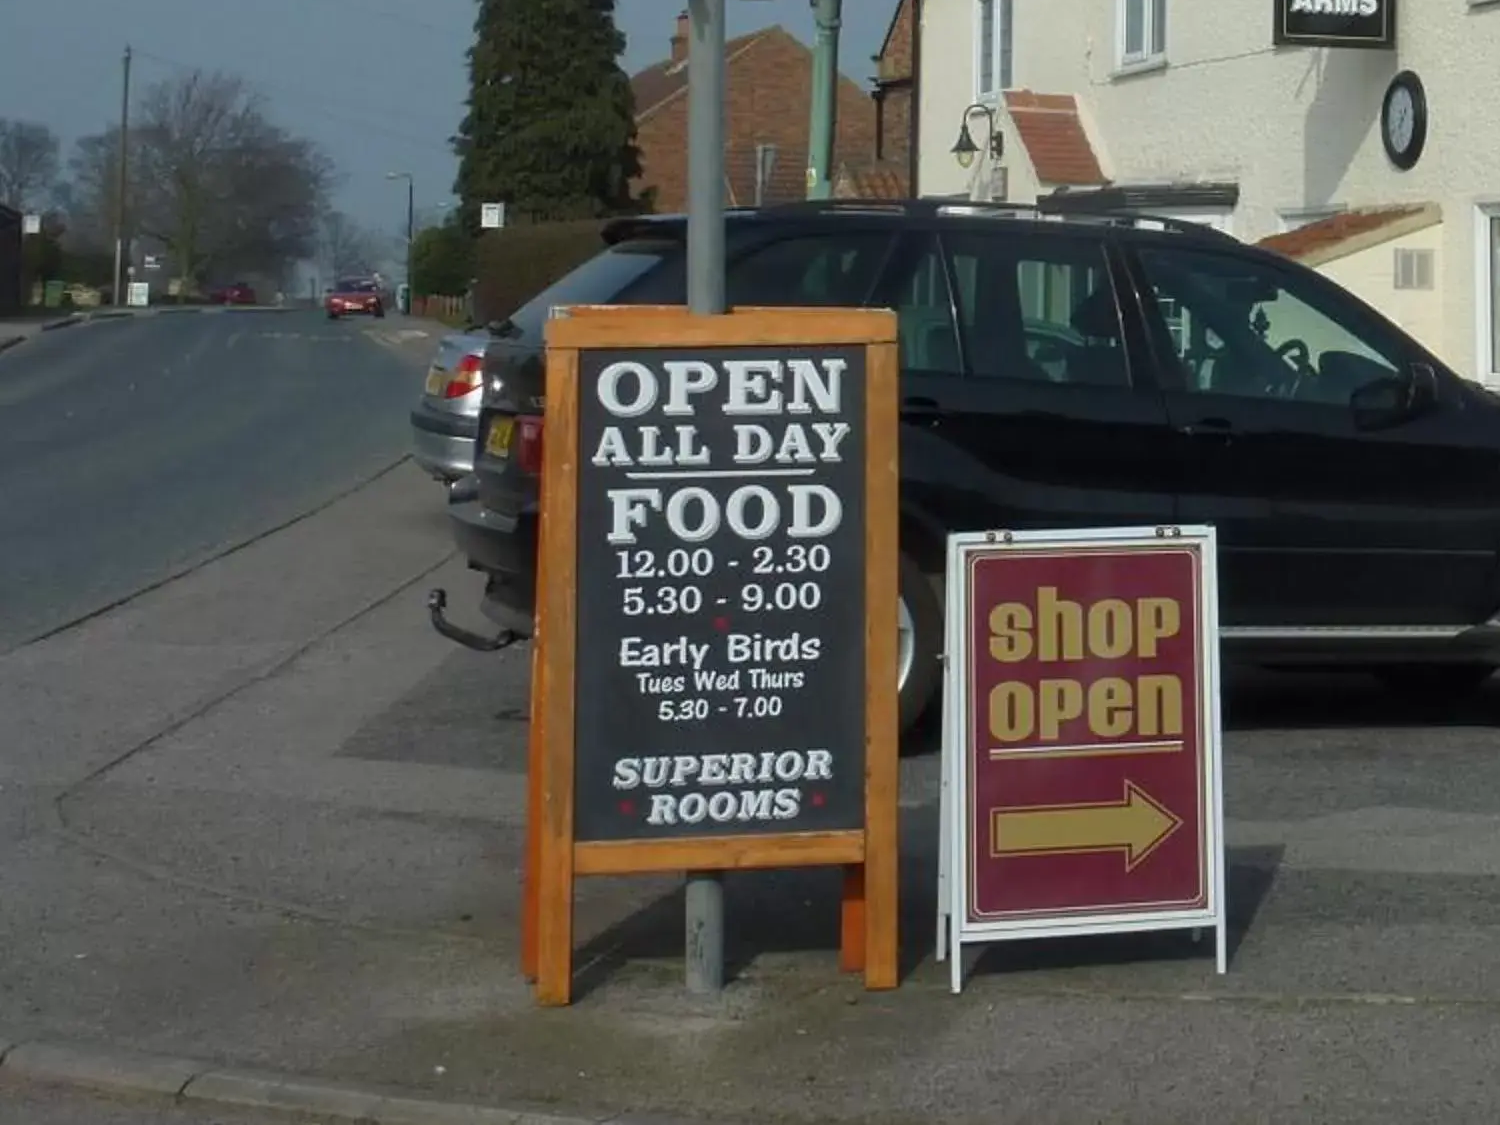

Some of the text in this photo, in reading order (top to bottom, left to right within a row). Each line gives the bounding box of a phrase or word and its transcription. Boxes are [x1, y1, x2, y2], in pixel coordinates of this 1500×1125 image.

[597, 359, 848, 418] OPEN
[591, 422, 851, 467] ALL DAY
[606, 484, 843, 545] FOOD
[615, 548, 715, 578] 12.00
[752, 544, 831, 574] 2.30
[622, 585, 703, 615] 5.30
[740, 581, 822, 611] 9.00
[988, 586, 1181, 663] shop
[618, 631, 822, 670] Early Birds
[635, 668, 805, 694] Tues Wed Thurs
[657, 698, 710, 721] 5.30
[733, 696, 783, 718] 7.00
[988, 674, 1184, 742] open
[613, 749, 834, 789] SUPERIOR
[646, 787, 803, 826] ROOMS
